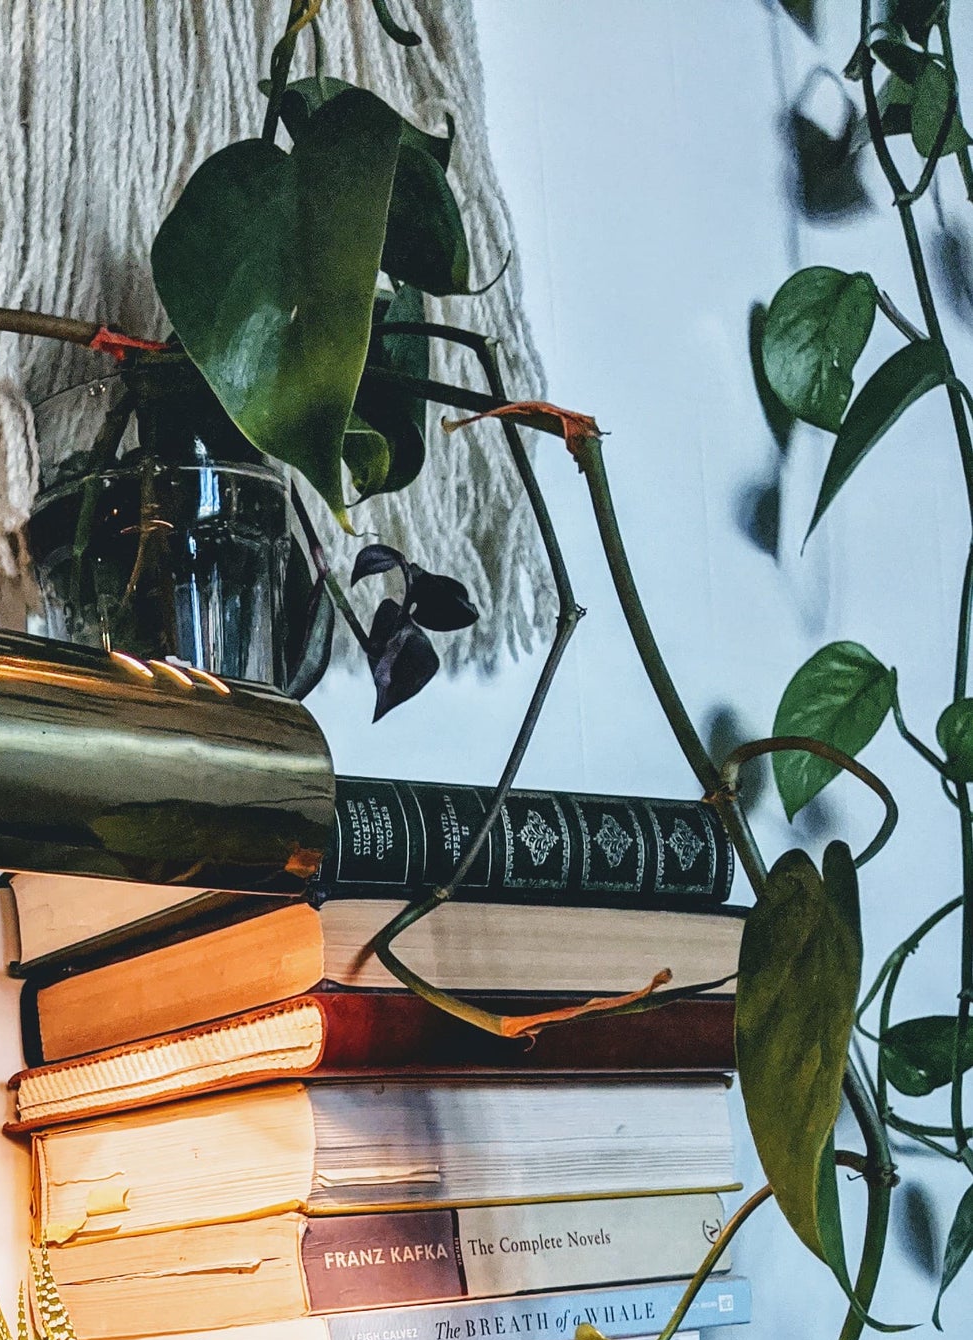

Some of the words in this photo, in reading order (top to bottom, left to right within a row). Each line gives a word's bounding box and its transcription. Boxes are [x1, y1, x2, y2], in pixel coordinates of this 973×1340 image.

[346, 799, 362, 856] CHARLES
[357, 801, 372, 856] DICKENS
[368, 797, 384, 860] COMPLETE
[380, 805, 394, 850] WORKS
[440, 812, 453, 850] DAVID
[324, 1247, 385, 1269] FRANZ
[390, 1243, 449, 1264] KAFKA
[468, 1238, 495, 1256] The
[500, 1235, 563, 1255] Complete
[567, 1229, 612, 1249] Novels
[382, 1328, 418, 1340] CALVEZ
[435, 1321, 461, 1340] The
[465, 1312, 549, 1338] BREATH
[555, 1309, 571, 1332] of
[573, 1314, 583, 1327] a
[583, 1301, 657, 1326] WHALE
